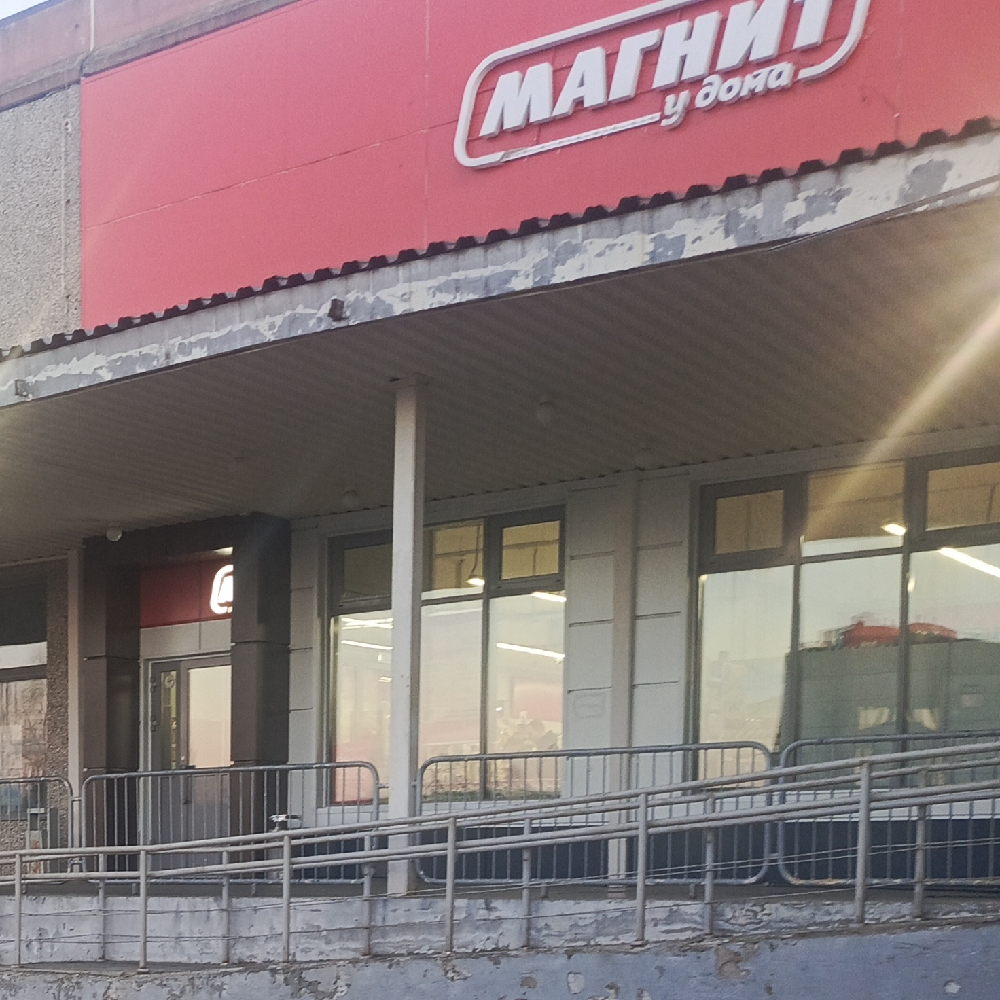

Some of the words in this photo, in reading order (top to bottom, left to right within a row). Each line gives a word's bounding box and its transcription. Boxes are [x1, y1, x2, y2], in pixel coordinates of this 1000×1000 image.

[478, 0, 834, 138] МАГНИТ
[659, 90, 691, 127] у
[694, 61, 797, 111] дома
